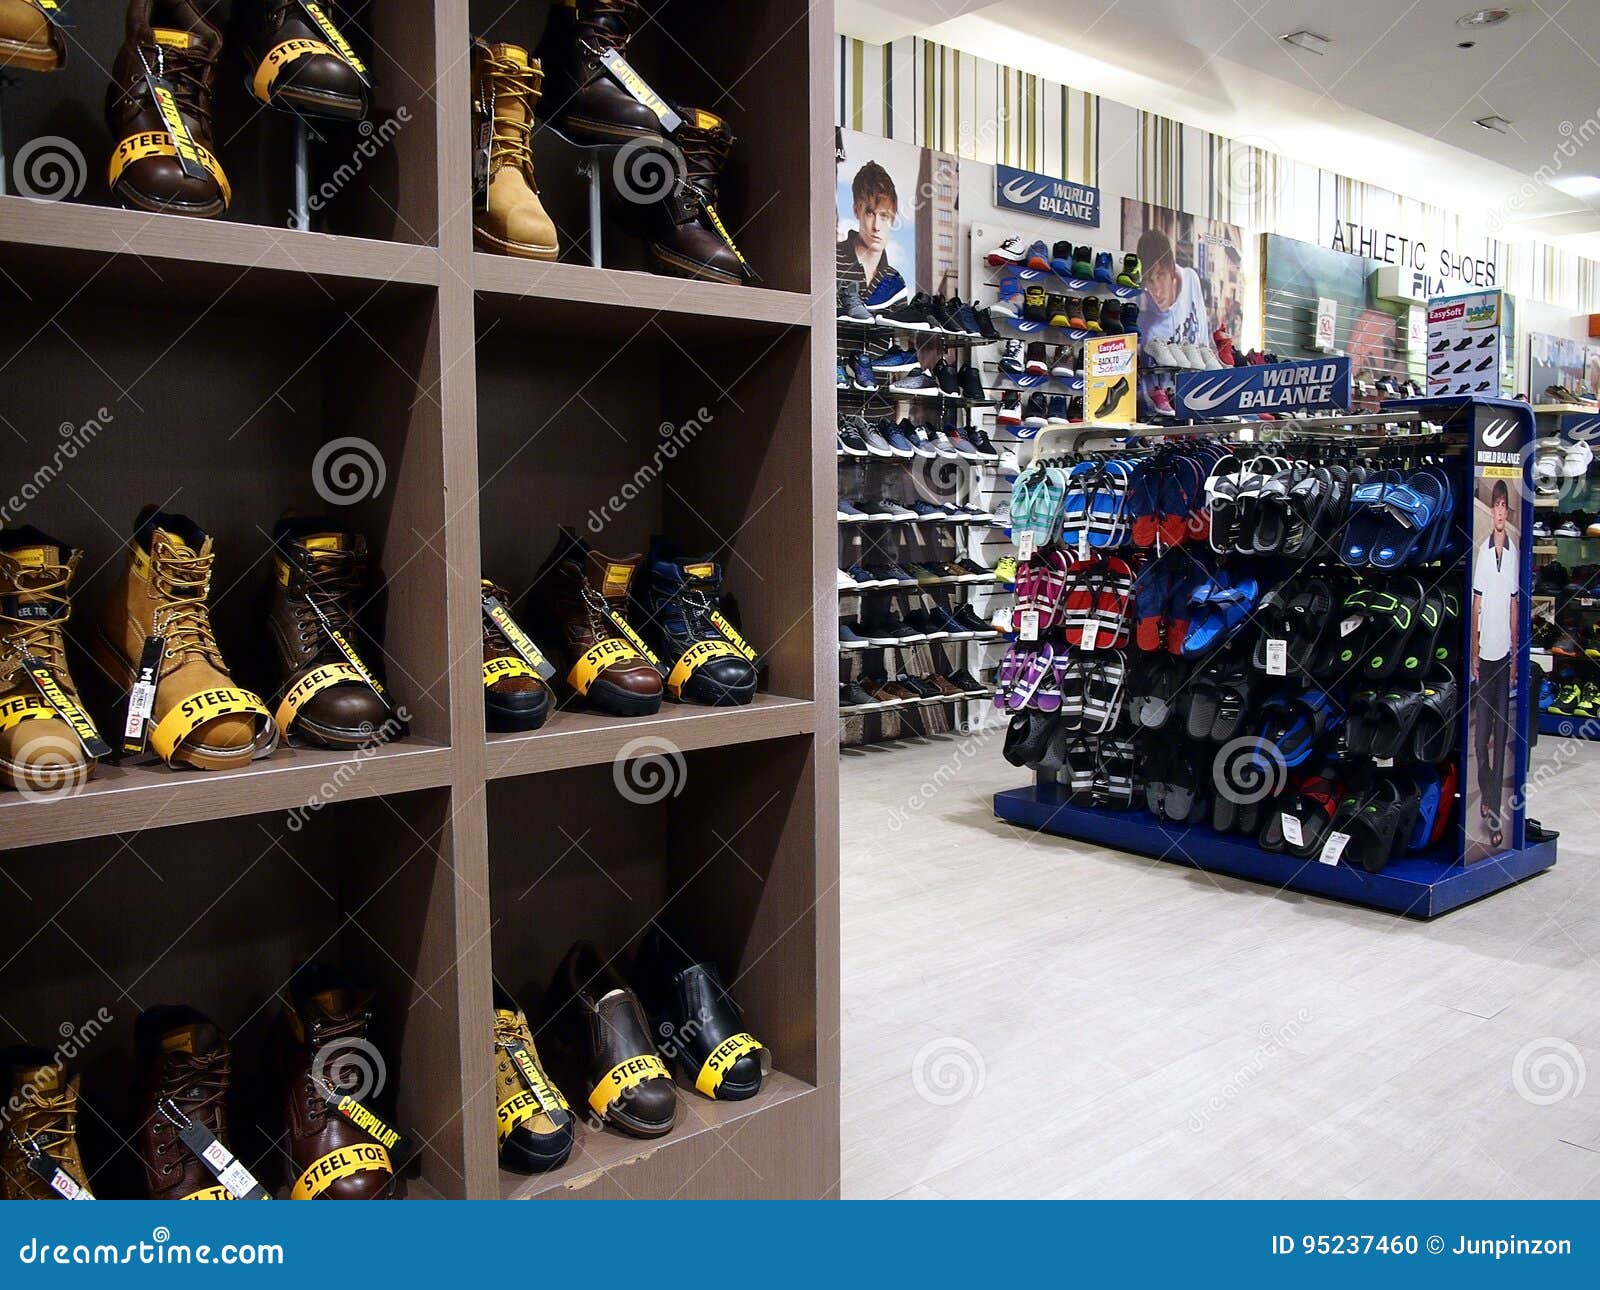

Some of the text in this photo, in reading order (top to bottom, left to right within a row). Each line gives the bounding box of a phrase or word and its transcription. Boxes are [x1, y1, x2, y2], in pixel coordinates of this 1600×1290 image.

[307, 4, 366, 73] CATERPILLAR
[154, 87, 199, 163] CATERPILLAR
[119, 133, 174, 159] STEEL
[1039, 195, 1092, 220] BALANCE
[1053, 182, 1094, 206] WORLD
[1332, 219, 1496, 287] ATHLETIC SHOES
[1413, 272, 1445, 298] FILA
[1429, 308, 1462, 320] EasySoft
[1099, 342, 1124, 352] EasySoft
[1263, 364, 1337, 388] WORLD
[1238, 384, 1333, 409] BALANCE
[1478, 450, 1521, 465] WORLD BALANCE
[491, 605, 545, 668] CATERPILLAR
[610, 610, 660, 665] CATERPILLAR
[710, 610, 757, 662] CATERPILLAR
[332, 630, 384, 694] CATERPILLAR
[586, 641, 628, 665] STEEL
[683, 641, 718, 667] STEEL
[287, 669, 333, 706] STEEL
[0, 696, 51, 714] TEEL
[32, 668, 98, 740] CATERPILLAR
[181, 690, 239, 718] STEEL
[709, 1039, 743, 1071] STEEL
[514, 1050, 560, 1111] CATERPILLAR
[611, 1058, 653, 1085] STEEL
[497, 1092, 535, 1122] STEE
[337, 1095, 400, 1149] CATERPILLAR
[304, 1146, 386, 1191] STEEL TOE
